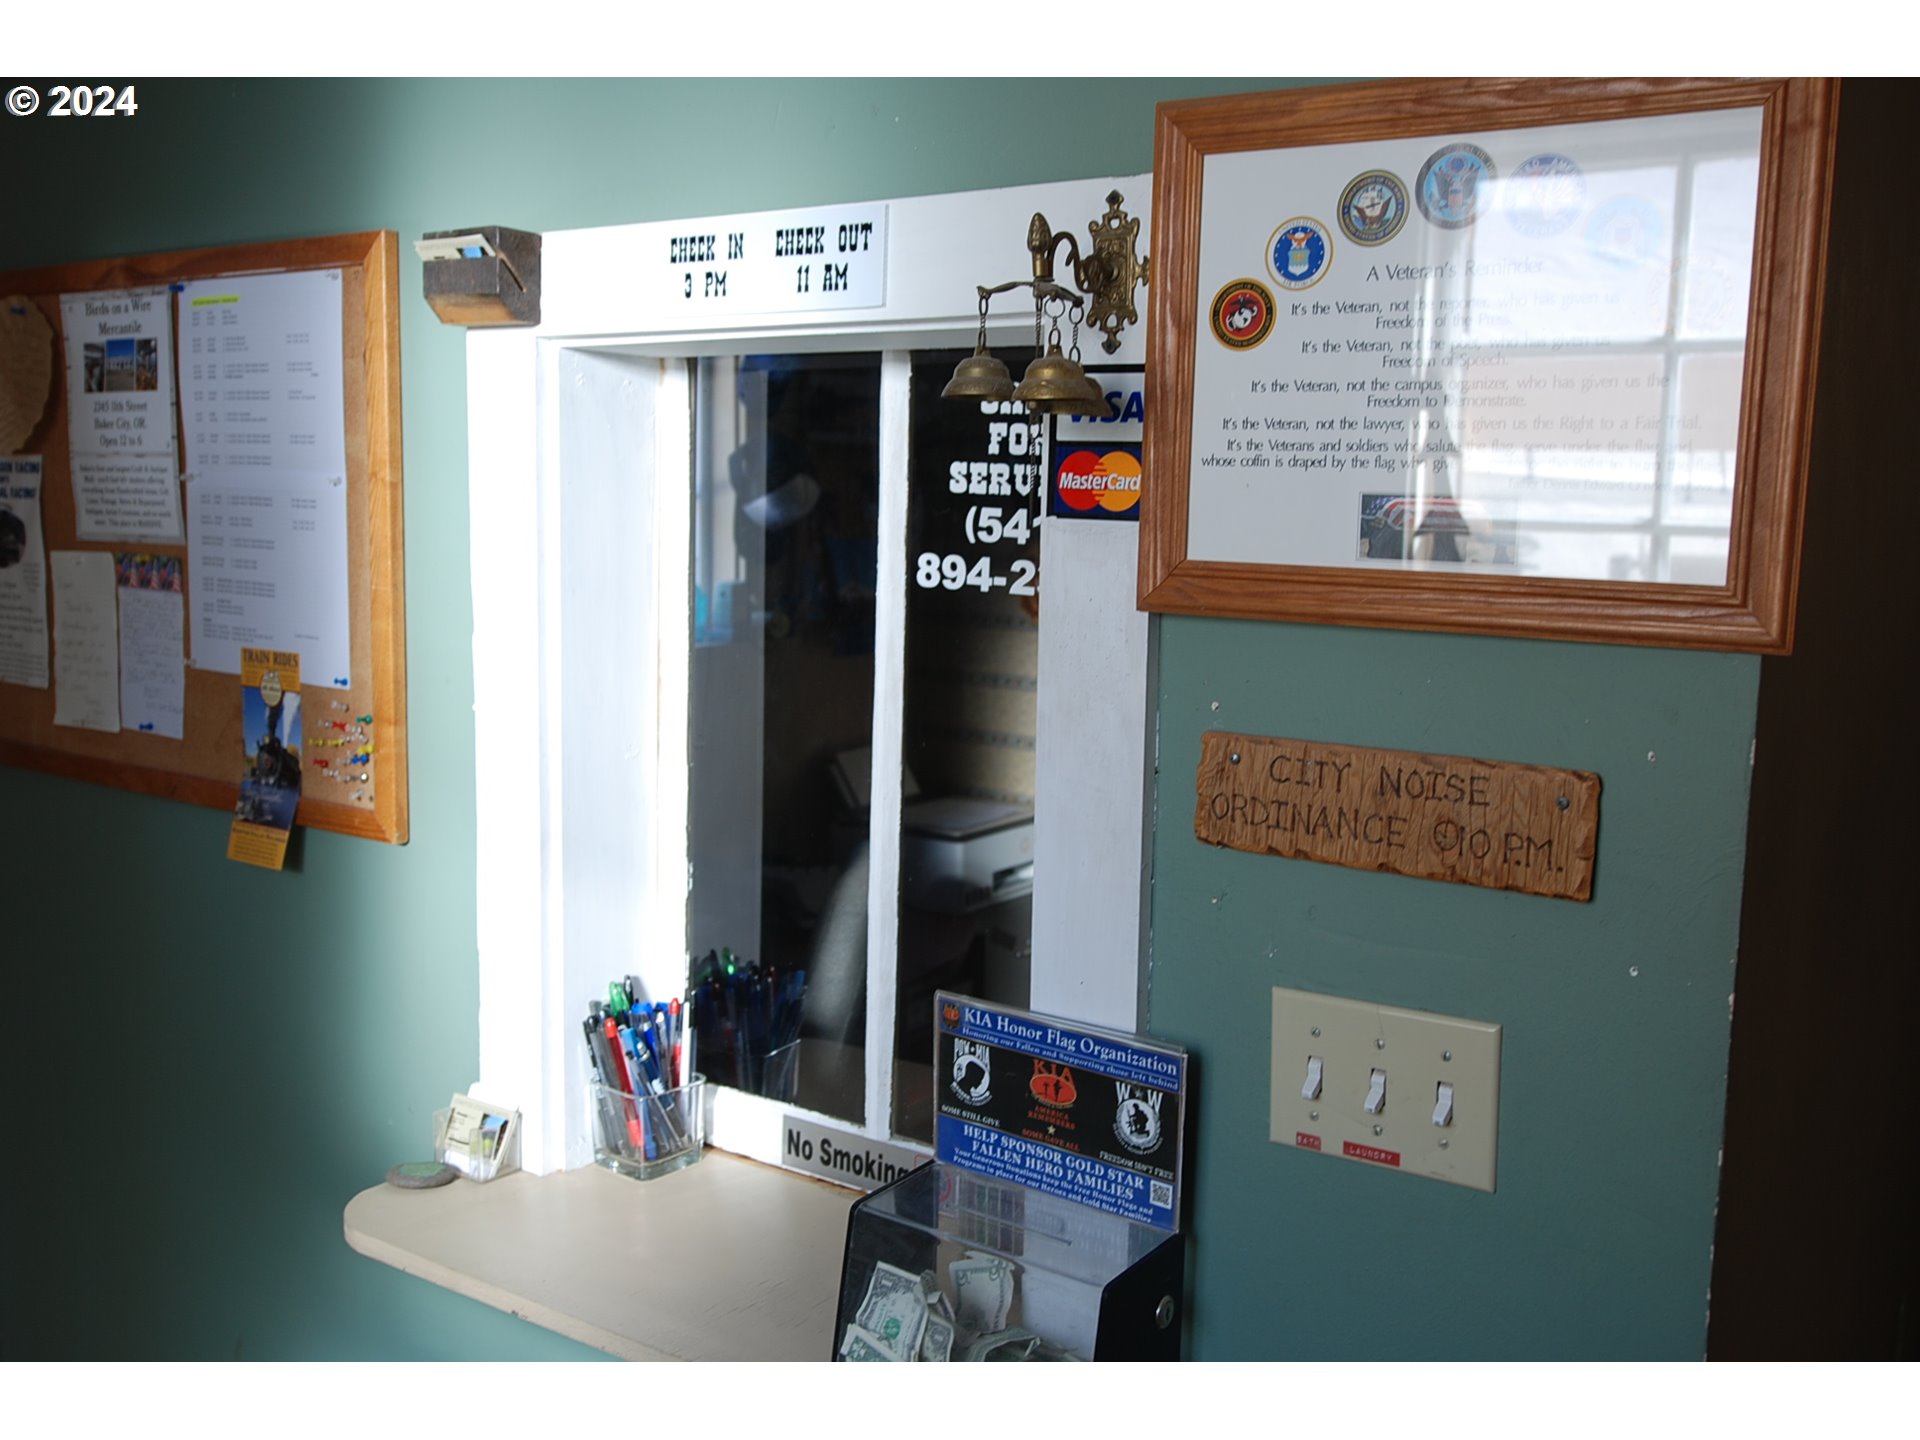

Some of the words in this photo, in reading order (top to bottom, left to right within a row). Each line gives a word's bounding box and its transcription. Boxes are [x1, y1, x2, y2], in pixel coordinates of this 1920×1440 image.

[670, 234, 717, 264] CHECK
[728, 232, 744, 260] IN
[775, 226, 825, 257] CHECK
[838, 221, 874, 253] OUT
[797, 264, 811, 294] 11
[822, 262, 849, 292] AM
[1366, 265, 1379, 281] A
[1386, 261, 1456, 281] Veteran's
[1465, 258, 1543, 278] Reminder
[684, 272, 693, 299] 3
[704, 270, 728, 298] PM
[84, 300, 110, 317] Birds
[112, 302, 122, 314] on
[130, 297, 152, 312] Wire
[1291, 302, 1307, 316] It's
[1313, 301, 1331, 315] the
[1336, 301, 1383, 316] Veteran,
[1389, 300, 1409, 312] not
[98, 320, 142, 336] Mercantile
[1435, 314, 1449, 328] of
[1302, 340, 1318, 354] It's
[1323, 339, 1341, 353] the
[1346, 339, 1393, 354] Veteran,
[1441, 351, 1456, 367] of
[1459, 352, 1510, 371] Speech.
[1251, 380, 1267, 393] It's
[1271, 379, 1289, 392] the
[1294, 379, 1340, 394] Veteran,
[1346, 378, 1366, 391] not
[1371, 377, 1389, 390] the
[1394, 380, 1443, 394] campus
[1516, 376, 1547, 388] who
[1552, 374, 1575, 388] has
[1579, 375, 1620, 394] given
[1624, 376, 1641, 388] us
[1647, 373, 1670, 387] the
[1068, 390, 1144, 424] SA
[1367, 394, 1420, 408] Freedom
[1426, 394, 1438, 407] to
[1222, 417, 1238, 430] It's
[1242, 416, 1260, 430] the
[1264, 416, 1310, 431] Veteran,
[1316, 417, 1335, 430] not
[1340, 416, 1358, 430] the
[1363, 416, 1405, 433] lawyer,
[1471, 417, 1506, 433] given
[1512, 418, 1527, 431] us
[1533, 416, 1554, 430] the
[1559, 415, 1594, 433] Right
[1600, 416, 1614, 430] to
[1619, 419, 1630, 431] a
[1635, 414, 1660, 430] Fair
[1227, 439, 1242, 452] It's
[1246, 438, 1264, 452] the
[1268, 439, 1315, 452] Veterans
[1319, 439, 1342, 452] and
[1345, 439, 1389, 452] soldiers
[1202, 455, 1236, 468] whose
[1240, 454, 1270, 468] coffin
[1275, 454, 1284, 468] is
[1288, 454, 1327, 471] draped
[1331, 455, 1346, 471] by
[1351, 455, 1370, 468] the
[1374, 455, 1396, 471] flag
[949, 460, 1042, 497] SERV
[1058, 471, 1141, 492] MasterCard
[964, 504, 1042, 546] (54
[915, 551, 1041, 597] 894-2
[243, 647, 269, 665] TRAIN
[1268, 754, 1352, 794] CITY
[1378, 765, 1491, 807] NOISE
[1209, 792, 1408, 850] ORDINANCE
[964, 1007, 992, 1029] KIA
[996, 1015, 1043, 1041] Honor
[1046, 1028, 1076, 1053] Flag
[1080, 1037, 1179, 1077] Organization
[962, 1026, 999, 1045] Honoring
[1000, 1037, 1015, 1049] our
[1016, 1040, 1040, 1055] Fallen
[1042, 1047, 1057, 1059] and
[1058, 1051, 1105, 1073] Supporting
[1106, 1063, 1129, 1077] those
[1130, 1069, 1147, 1081] left
[1148, 1073, 1179, 1091] behind
[1033, 1058, 1073, 1084] KIA
[941, 1103, 961, 1116] SOME
[962, 1109, 981, 1121] STILL
[982, 1115, 1001, 1126] GIVE
[1035, 1104, 1070, 1121] AMERICA
[787, 1128, 814, 1162] No
[1297, 1134, 1321, 1149] BATH
[1349, 1144, 1393, 1162] LAUNDRY
[963, 1124, 998, 1145] HELP
[1000, 1135, 1064, 1165] SPONSOR
[1065, 1154, 1105, 1178] GOLD
[1106, 1167, 1144, 1190] STAR
[1099, 1150, 1133, 1168] FREEDOM
[1154, 1167, 1175, 1181] FREE
[955, 1147, 972, 1159] Your
[972, 1152, 1005, 1169] Generous
[1005, 1162, 1041, 1179] Donations
[1042, 1173, 1060, 1188] keep
[1060, 1179, 1073, 1189] the
[1073, 1183, 1090, 1195] Free
[1091, 1189, 1115, 1204] Honor
[1116, 1197, 1138, 1212] Flags
[1138, 1206, 1154, 1218] and
[971, 1140, 1023, 1165] FALLEN
[1024, 1156, 1064, 1179] HERO
[1066, 1170, 1134, 1201] FAMILIES
[953, 1155, 985, 1173] Programs
[994, 1167, 1013, 1182] place
[1014, 1173, 1026, 1185] for
[1026, 1177, 1040, 1189] our
[1041, 1181, 1067, 1197] Heroes
[1068, 1191, 1082, 1203] and
[1082, 1195, 1100, 1209] Gold
[1101, 1202, 1118, 1214] Star
[1118, 1206, 1152, 1225] Families
